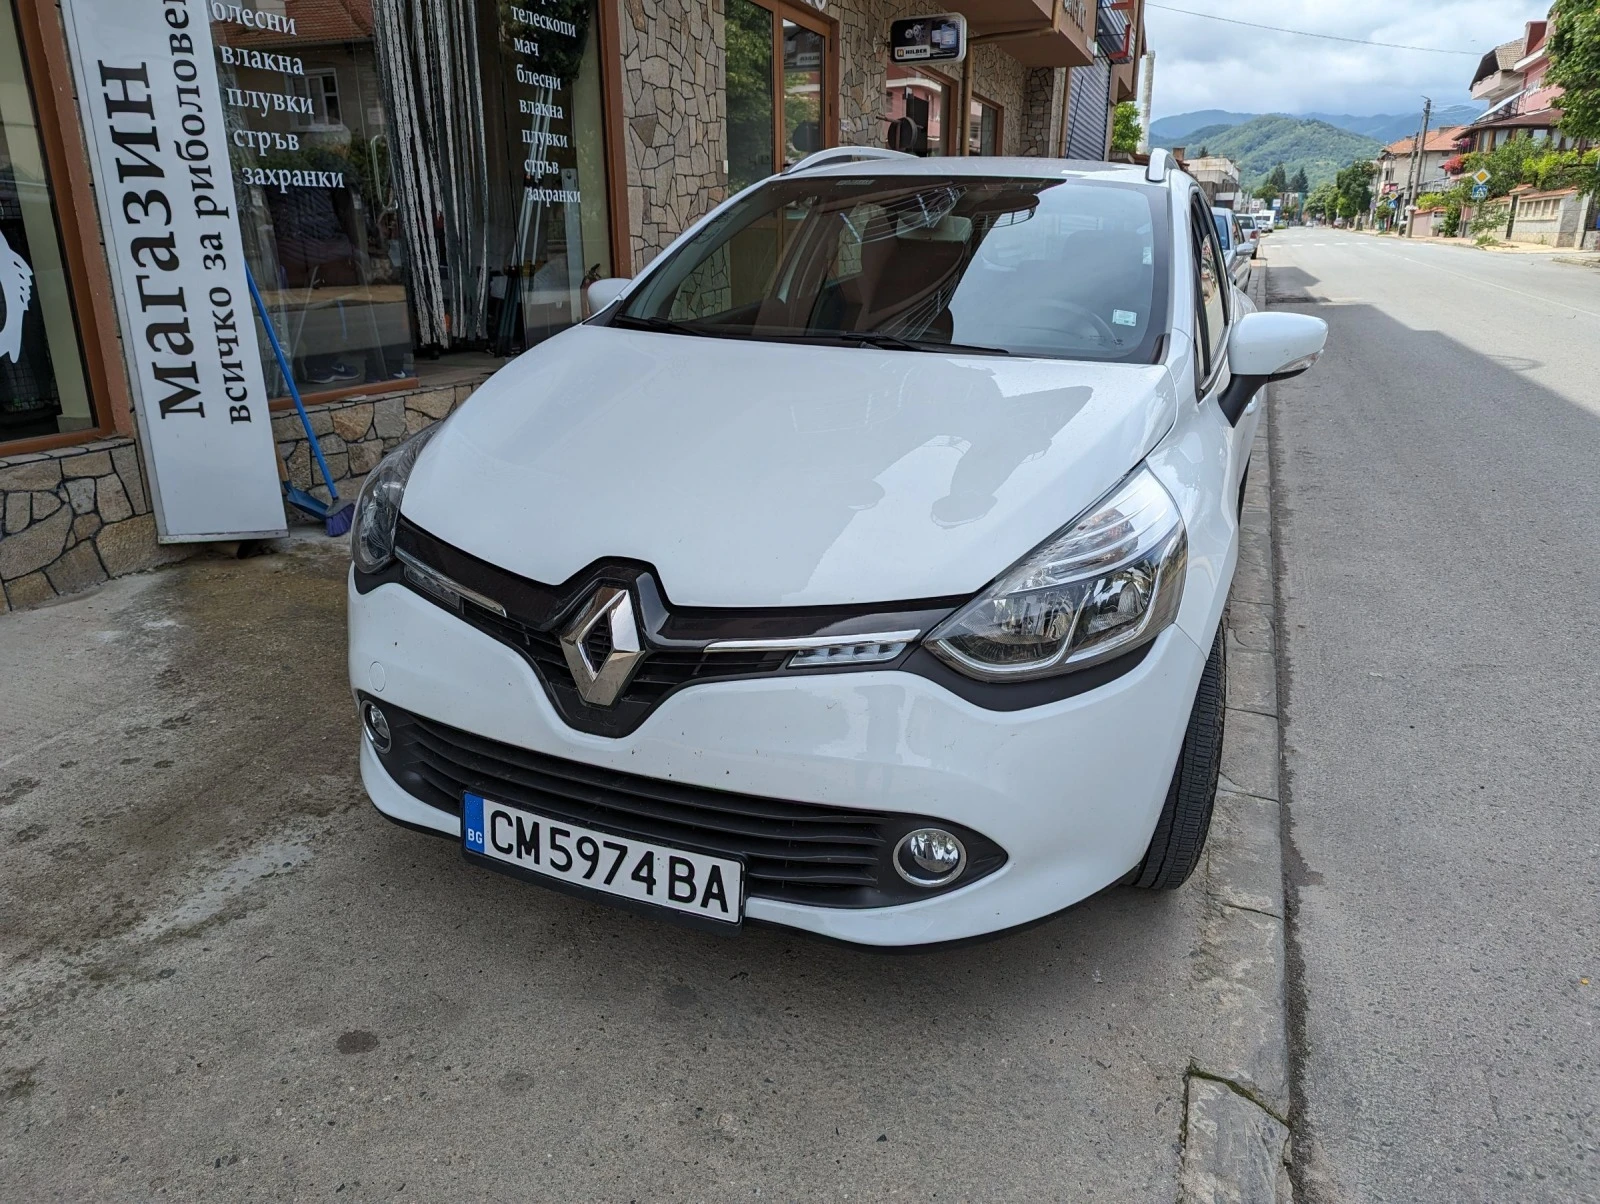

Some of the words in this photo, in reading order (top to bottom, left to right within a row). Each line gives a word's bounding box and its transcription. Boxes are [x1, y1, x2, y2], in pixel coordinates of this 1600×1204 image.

[511, 6, 577, 38] телескопи
[219, 45, 305, 76] влакна
[514, 37, 540, 57] мач
[516, 64, 562, 91] блесни
[226, 87, 315, 117] плувки
[519, 98, 564, 120] влакна
[233, 127, 300, 156] стръв
[522, 129, 568, 150] плувки
[242, 165, 345, 196] захранки
[524, 158, 559, 183] стръв
[526, 186, 582, 208] захранки
[99, 59, 205, 420] Магазин
[204, 231, 227, 271] за
[209, 286, 252, 425] всичко
[467, 828, 483, 844] BG
